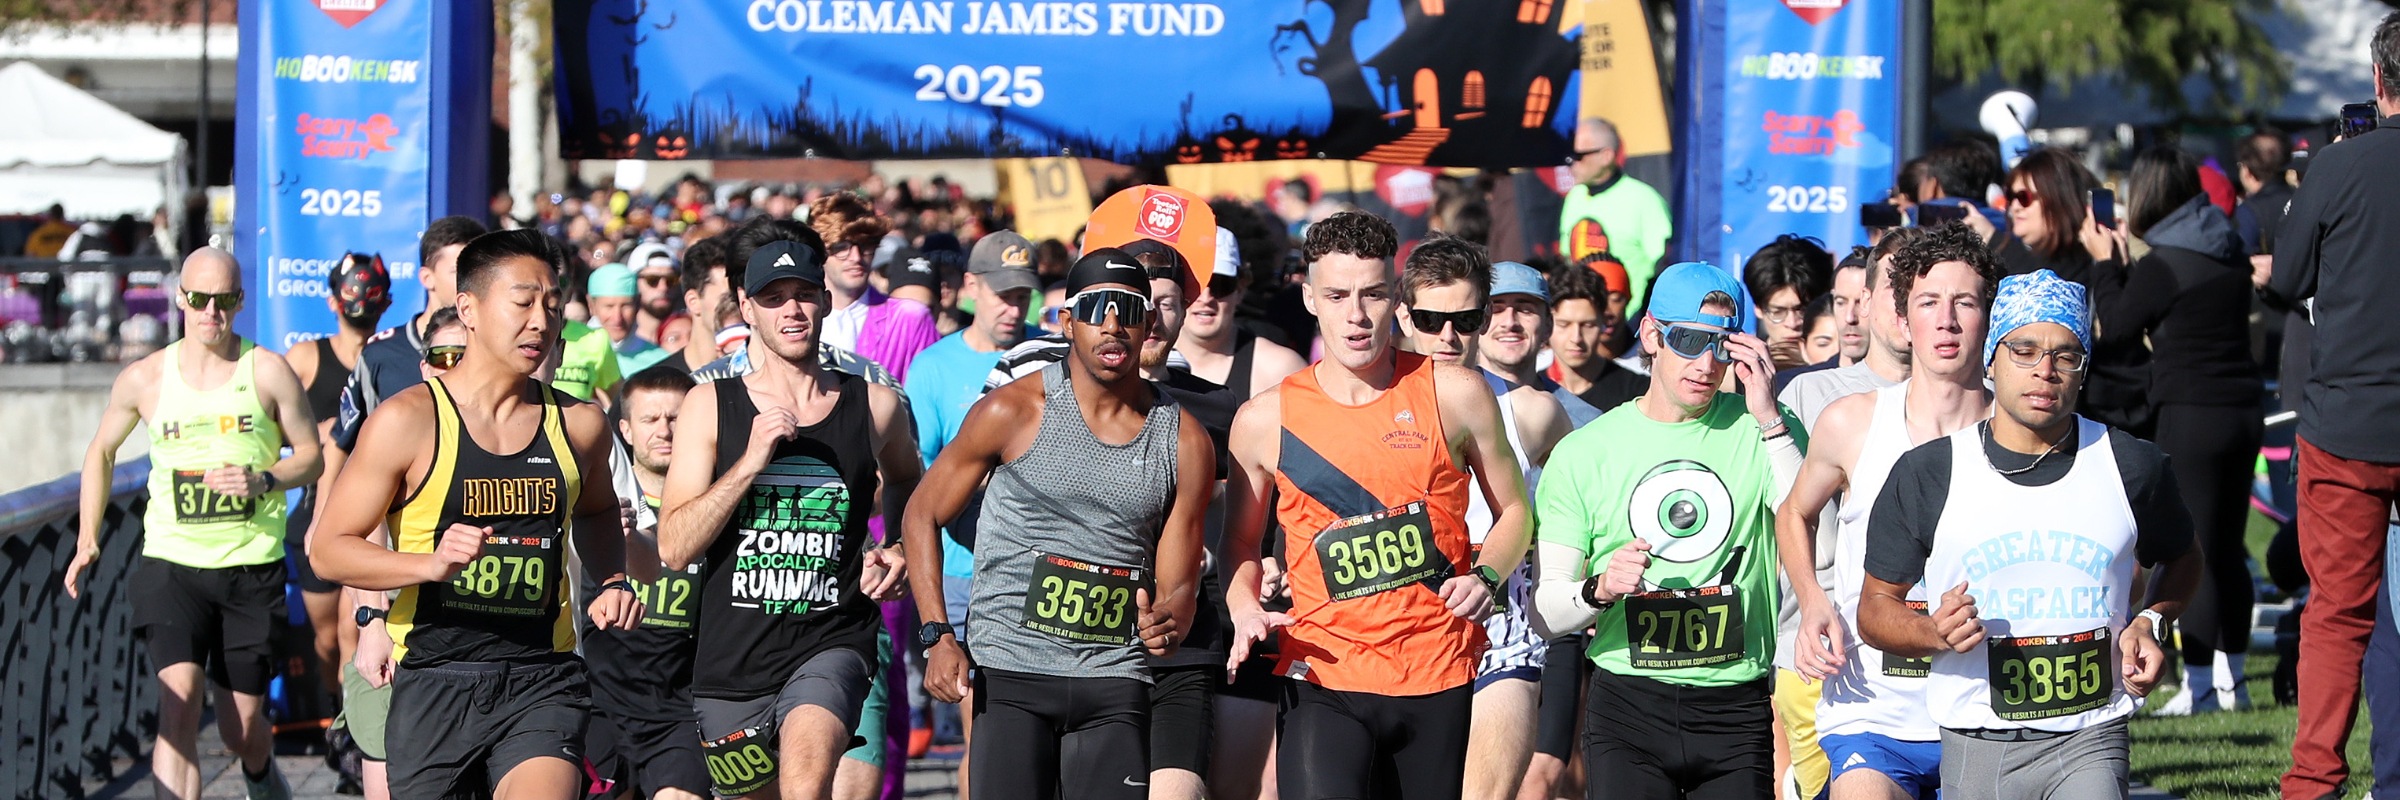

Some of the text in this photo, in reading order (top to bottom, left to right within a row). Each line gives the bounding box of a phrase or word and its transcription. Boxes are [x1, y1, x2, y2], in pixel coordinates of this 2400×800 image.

[747, 0, 1225, 36] COLEMAN JAMES FUND
[275, 55, 418, 83] HOBOOKEN5K
[914, 64, 1045, 108] 2025
[296, 113, 357, 139] Scary
[1762, 110, 1825, 135] Scary
[302, 135, 370, 160] Scurry
[1768, 132, 1834, 156] Scurry
[300, 188, 383, 217] 2025
[1767, 185, 1848, 213] 2025
[1148, 210, 1175, 229] POP
[1001, 245, 1029, 266] Cal
[1382, 430, 1429, 443] CENTRAL PARK
[463, 478, 556, 518] KNIGHTS
[1387, 506, 1407, 518] 2025
[521, 537, 540, 546] 2025
[737, 529, 845, 562] ZOMBIE
[735, 553, 839, 577] APOCALYPSE
[1328, 524, 1425, 585] 3569
[1961, 530, 2114, 583] GREATER
[453, 555, 545, 601] 3879
[1112, 568, 1130, 577] 2025
[626, 575, 691, 616] 412
[731, 568, 839, 603] RUNNING
[1335, 591, 1347, 600] LIVE
[1347, 587, 1369, 599] RESULTS
[1368, 585, 1376, 593] AT
[1700, 586, 1720, 596] 2025
[1036, 575, 1130, 629] 3533
[1026, 620, 1039, 629] LIVE
[1038, 623, 1061, 636] RESULTS
[1061, 628, 1069, 637] AT
[1637, 604, 1729, 654] 2767
[2073, 632, 2093, 643] 2025
[1637, 659, 1648, 667] LIVE
[1647, 659, 1669, 668] RESULTS
[1669, 659, 1677, 667] AT
[1888, 667, 1901, 675] LIVE
[1901, 668, 1925, 677] RESULTS
[2002, 648, 2101, 705] 3855
[2012, 711, 2037, 720] RESULTS
[2037, 710, 2045, 718] AT
[726, 730, 745, 743] 2025
[704, 744, 774, 787] 009
